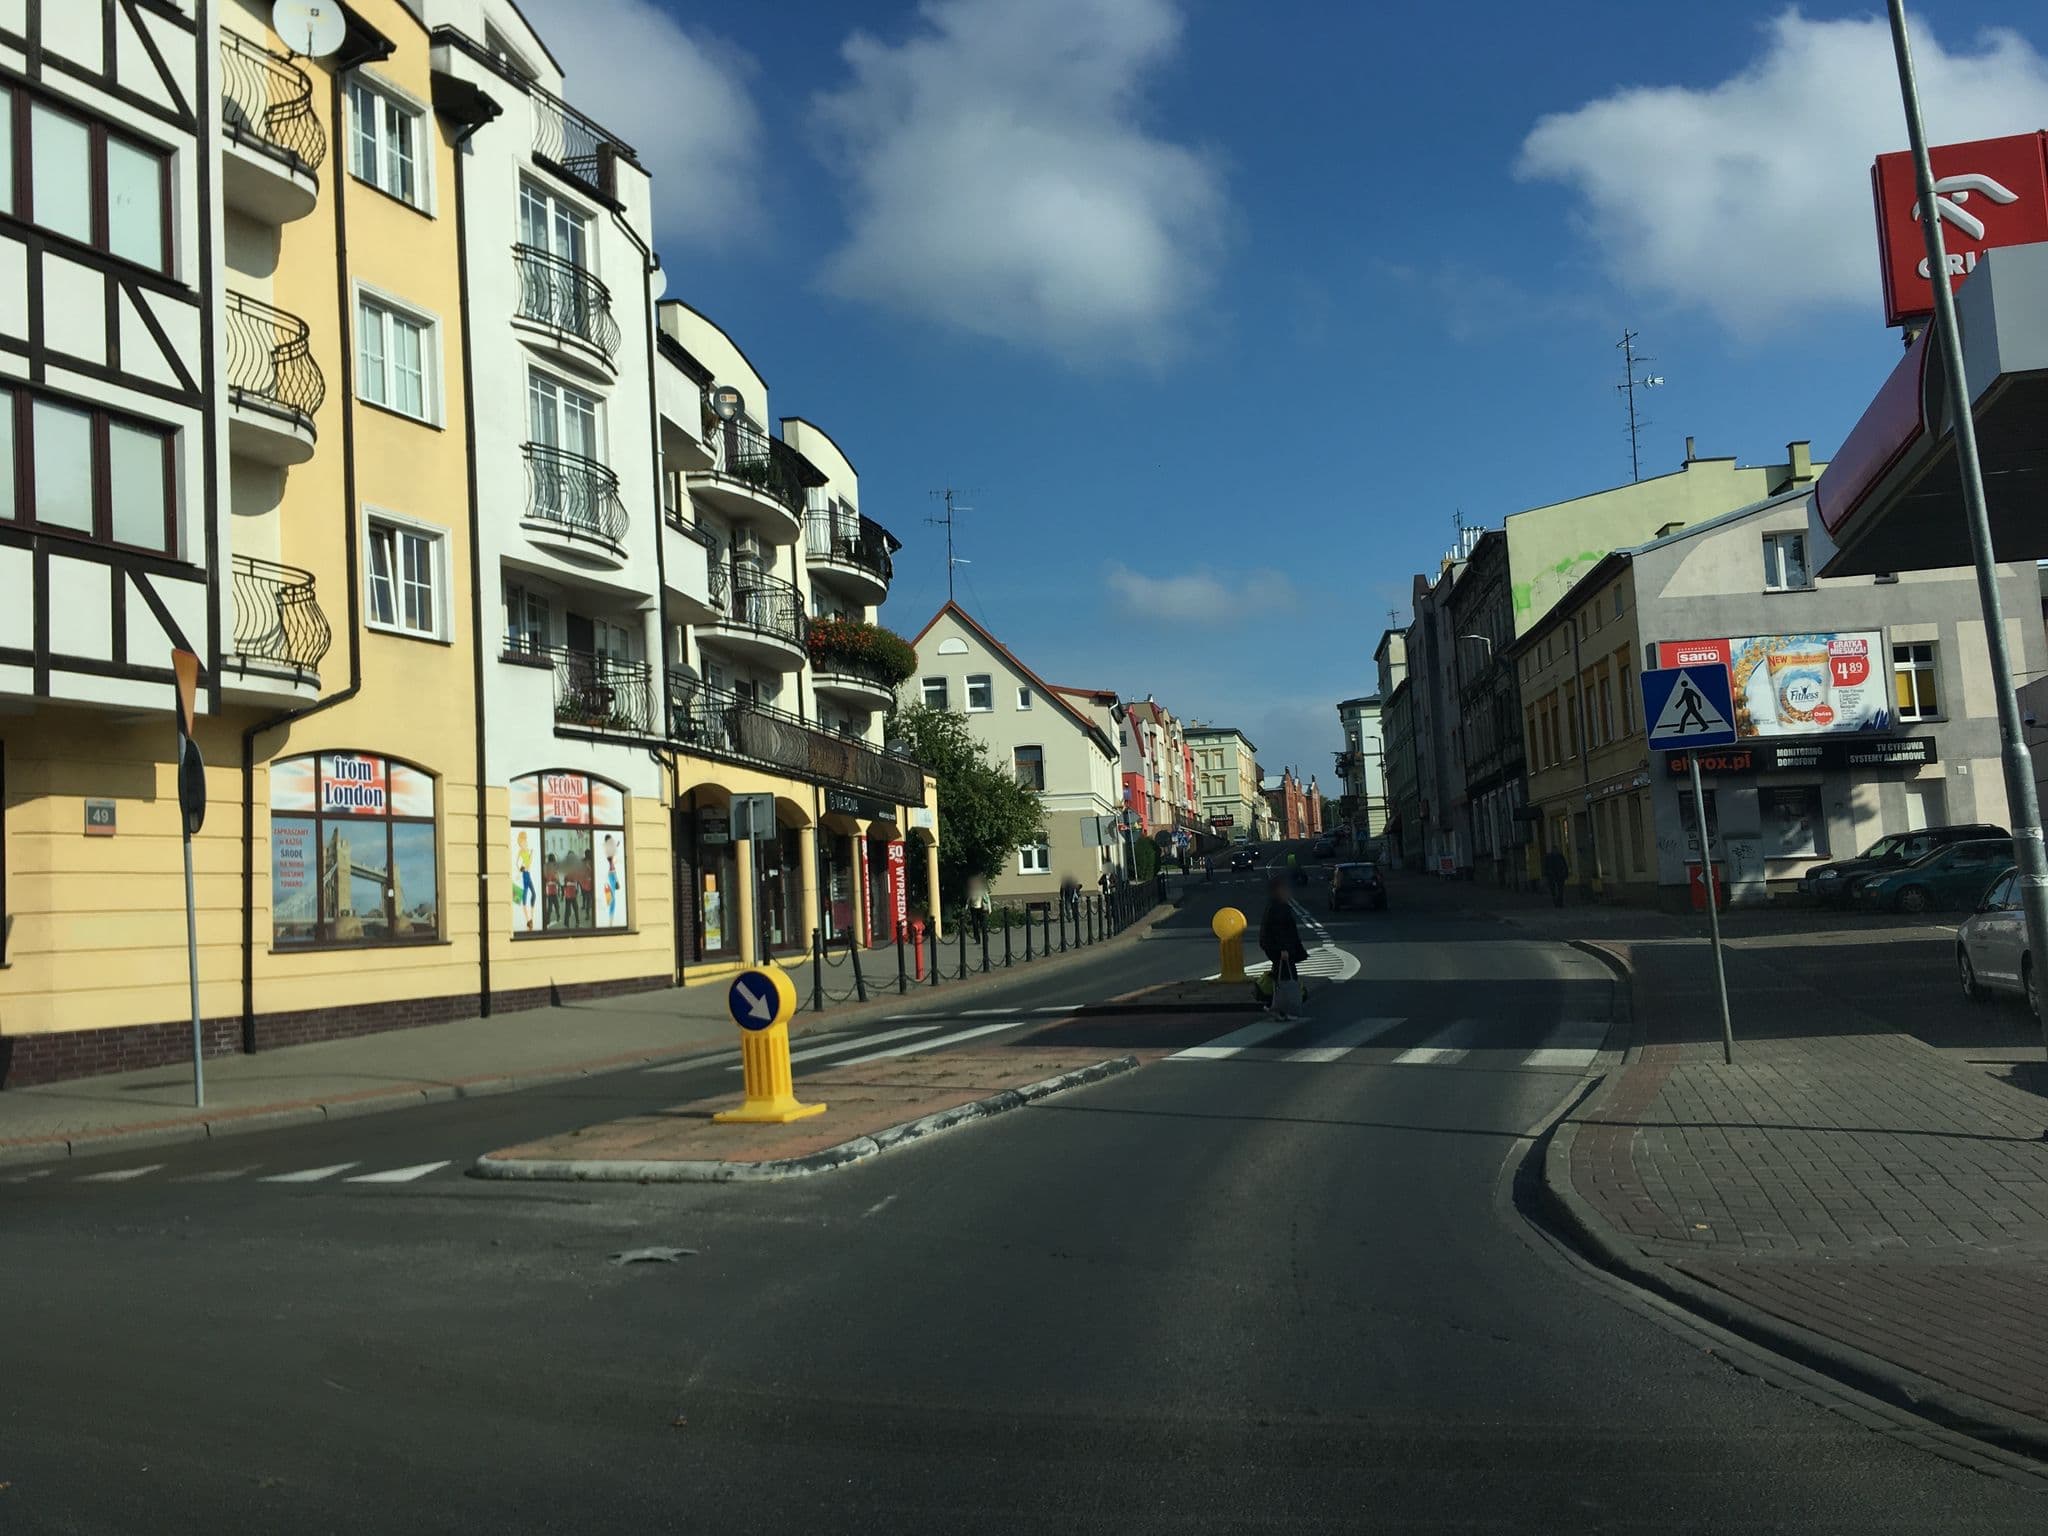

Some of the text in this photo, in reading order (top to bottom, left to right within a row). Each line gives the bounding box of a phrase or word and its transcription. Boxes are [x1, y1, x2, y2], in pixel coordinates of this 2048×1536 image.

[1680, 652, 1717, 662] sano
[1768, 656, 1788, 667] NEW
[1776, 747, 1823, 757] MONITORING
[1876, 741, 1924, 752] TV CYFROWA
[1671, 754, 1752, 771] elrox.pl
[1777, 757, 1817, 767] DOMOFONY
[1850, 751, 1925, 764] SYSTEMY ALARMOWE
[334, 755, 372, 782] from
[547, 776, 583, 797] SECOND
[324, 782, 384, 807] London
[553, 799, 580, 817] HAND
[92, 808, 110, 824] 49
